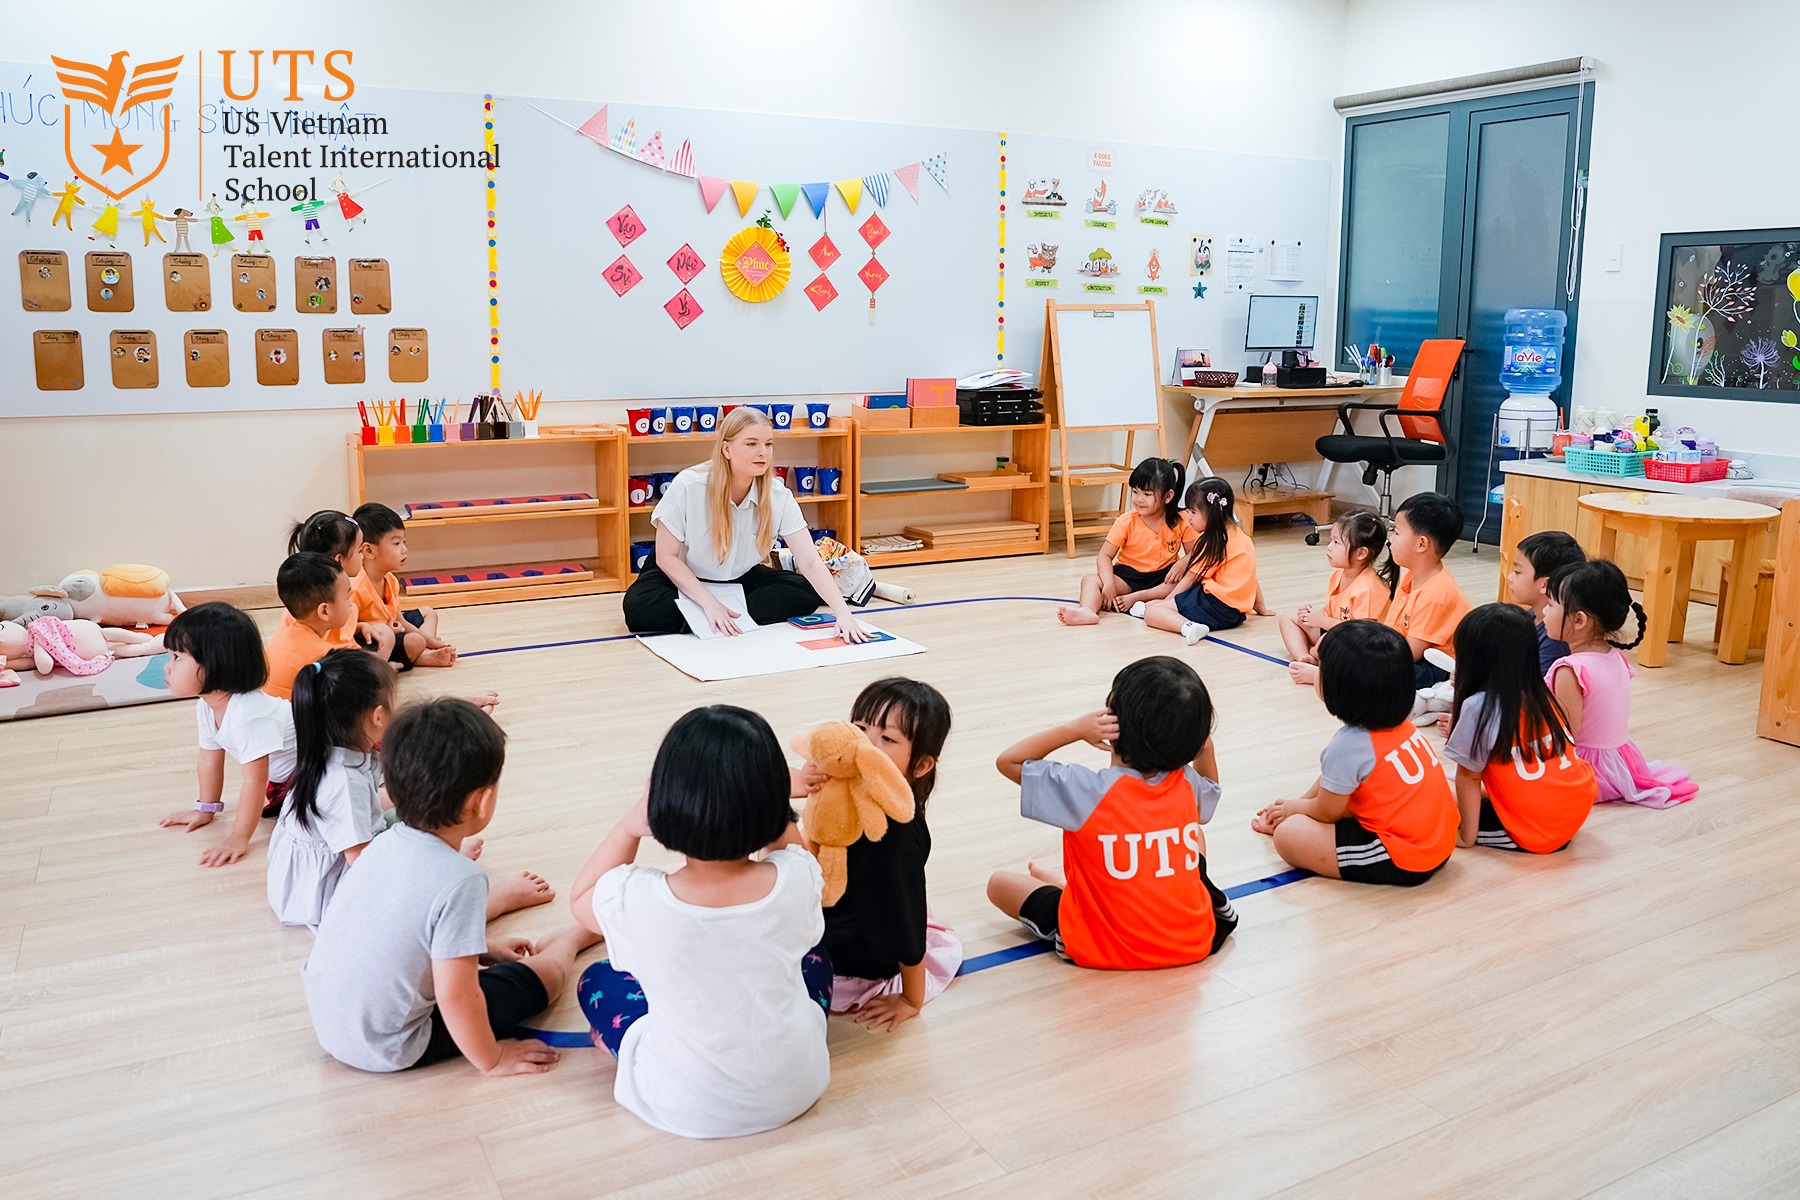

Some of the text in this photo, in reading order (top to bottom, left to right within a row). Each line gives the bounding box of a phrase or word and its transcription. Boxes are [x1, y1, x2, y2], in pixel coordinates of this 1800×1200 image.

[0, 74, 59, 126] ÚC
[742, 256, 769, 270] Phúc
[1514, 352, 1542, 362] laVie
[704, 418, 711, 426] d
[780, 414, 786, 423] g
[816, 415, 822, 423] h
[658, 421, 664, 429] b
[806, 478, 812, 487] p
[1511, 726, 1580, 781] UT
[1098, 822, 1200, 880] UTS
